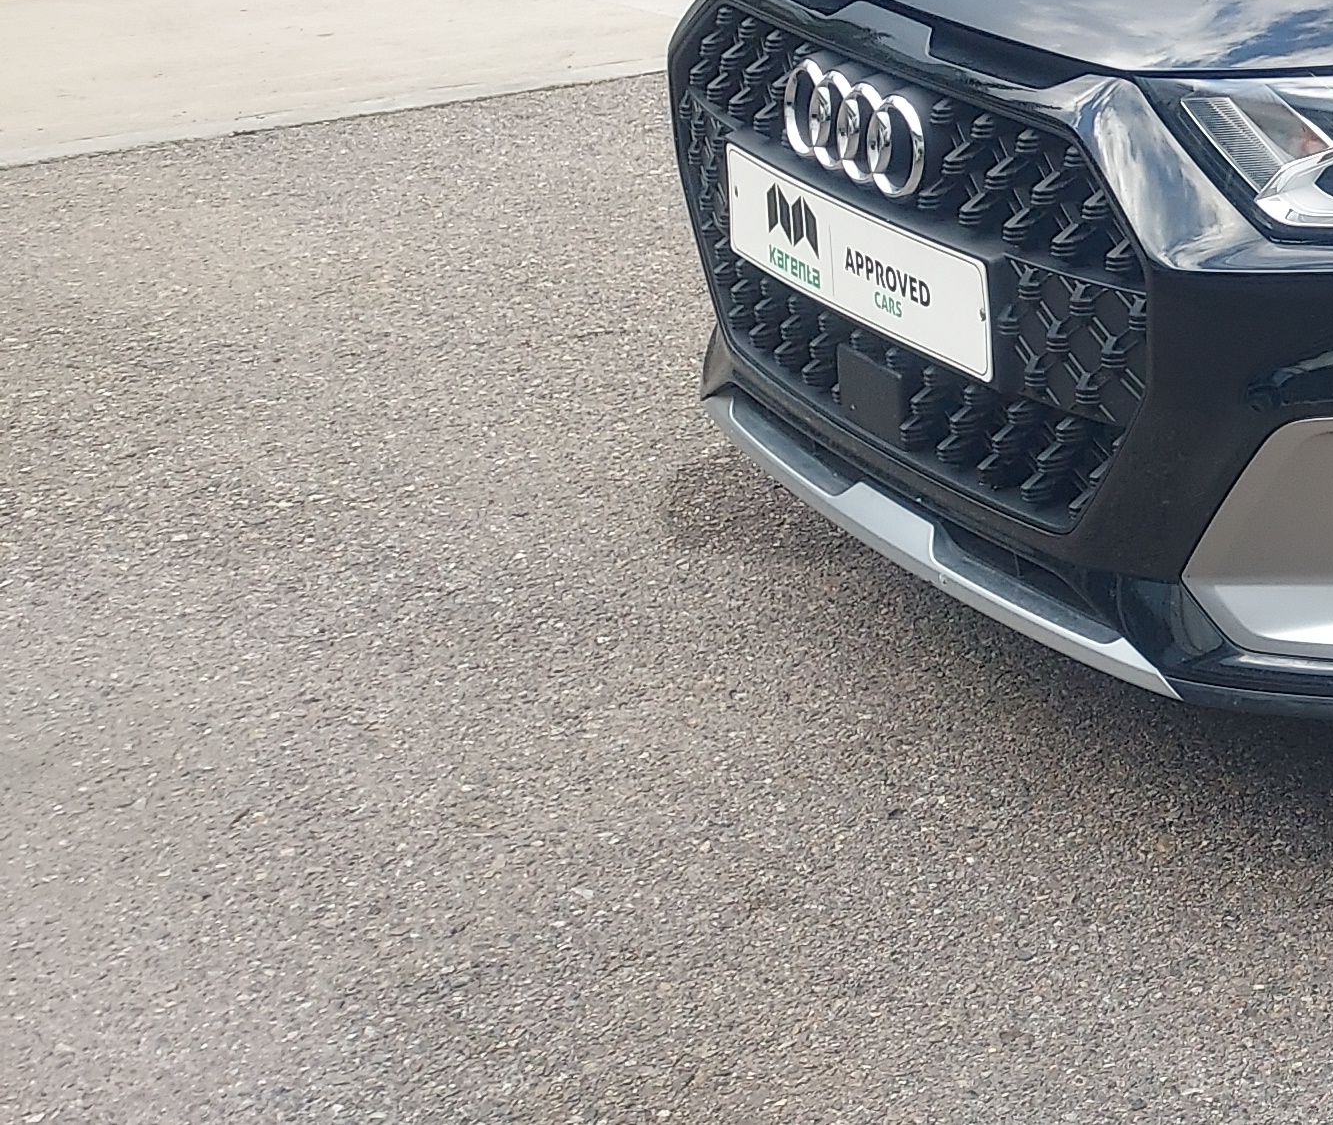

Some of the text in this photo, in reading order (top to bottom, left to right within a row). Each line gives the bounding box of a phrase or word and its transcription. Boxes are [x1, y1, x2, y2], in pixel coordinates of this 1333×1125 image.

[768, 244, 821, 290] karenta
[845, 246, 931, 307] APPROVED
[874, 291, 903, 318] CARS
